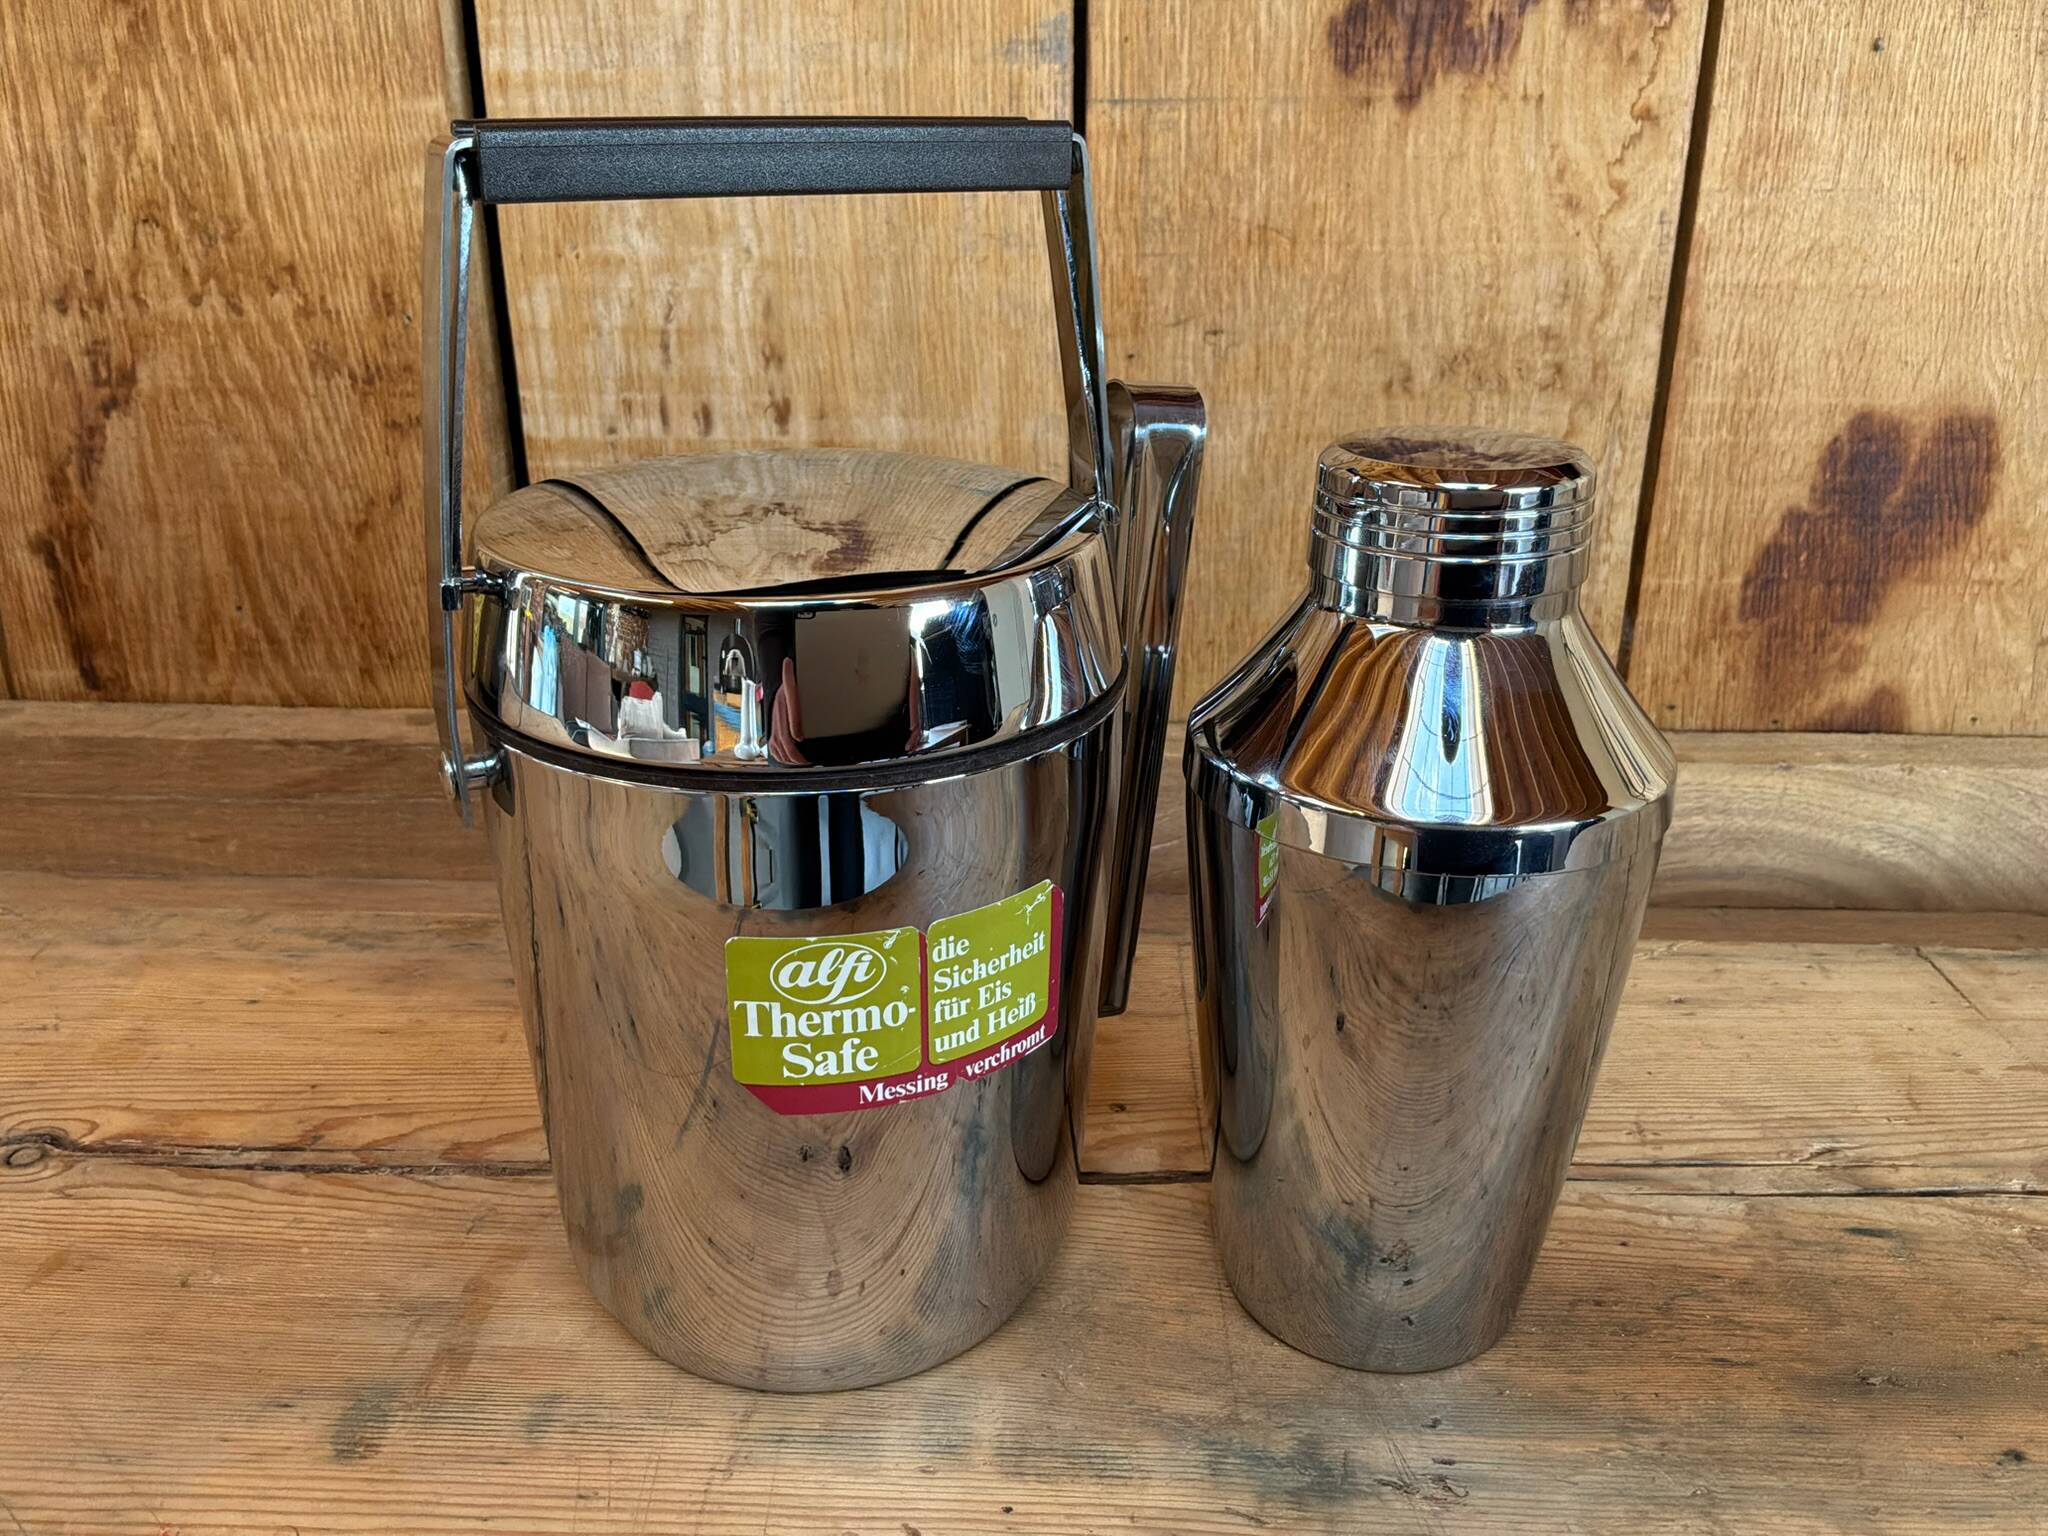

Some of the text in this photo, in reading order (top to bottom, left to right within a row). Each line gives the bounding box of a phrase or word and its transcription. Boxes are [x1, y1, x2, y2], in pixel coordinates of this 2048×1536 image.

[932, 935, 970, 963] die
[933, 930, 1045, 993] Sicherheit
[777, 947, 876, 1004] alfi
[734, 999, 916, 1038] Thermo-
[933, 980, 1012, 1024] für Eis
[934, 992, 1036, 1053] und Heiß
[783, 1038, 878, 1078] Safe
[859, 1024, 1046, 1104] Messing verchromt
